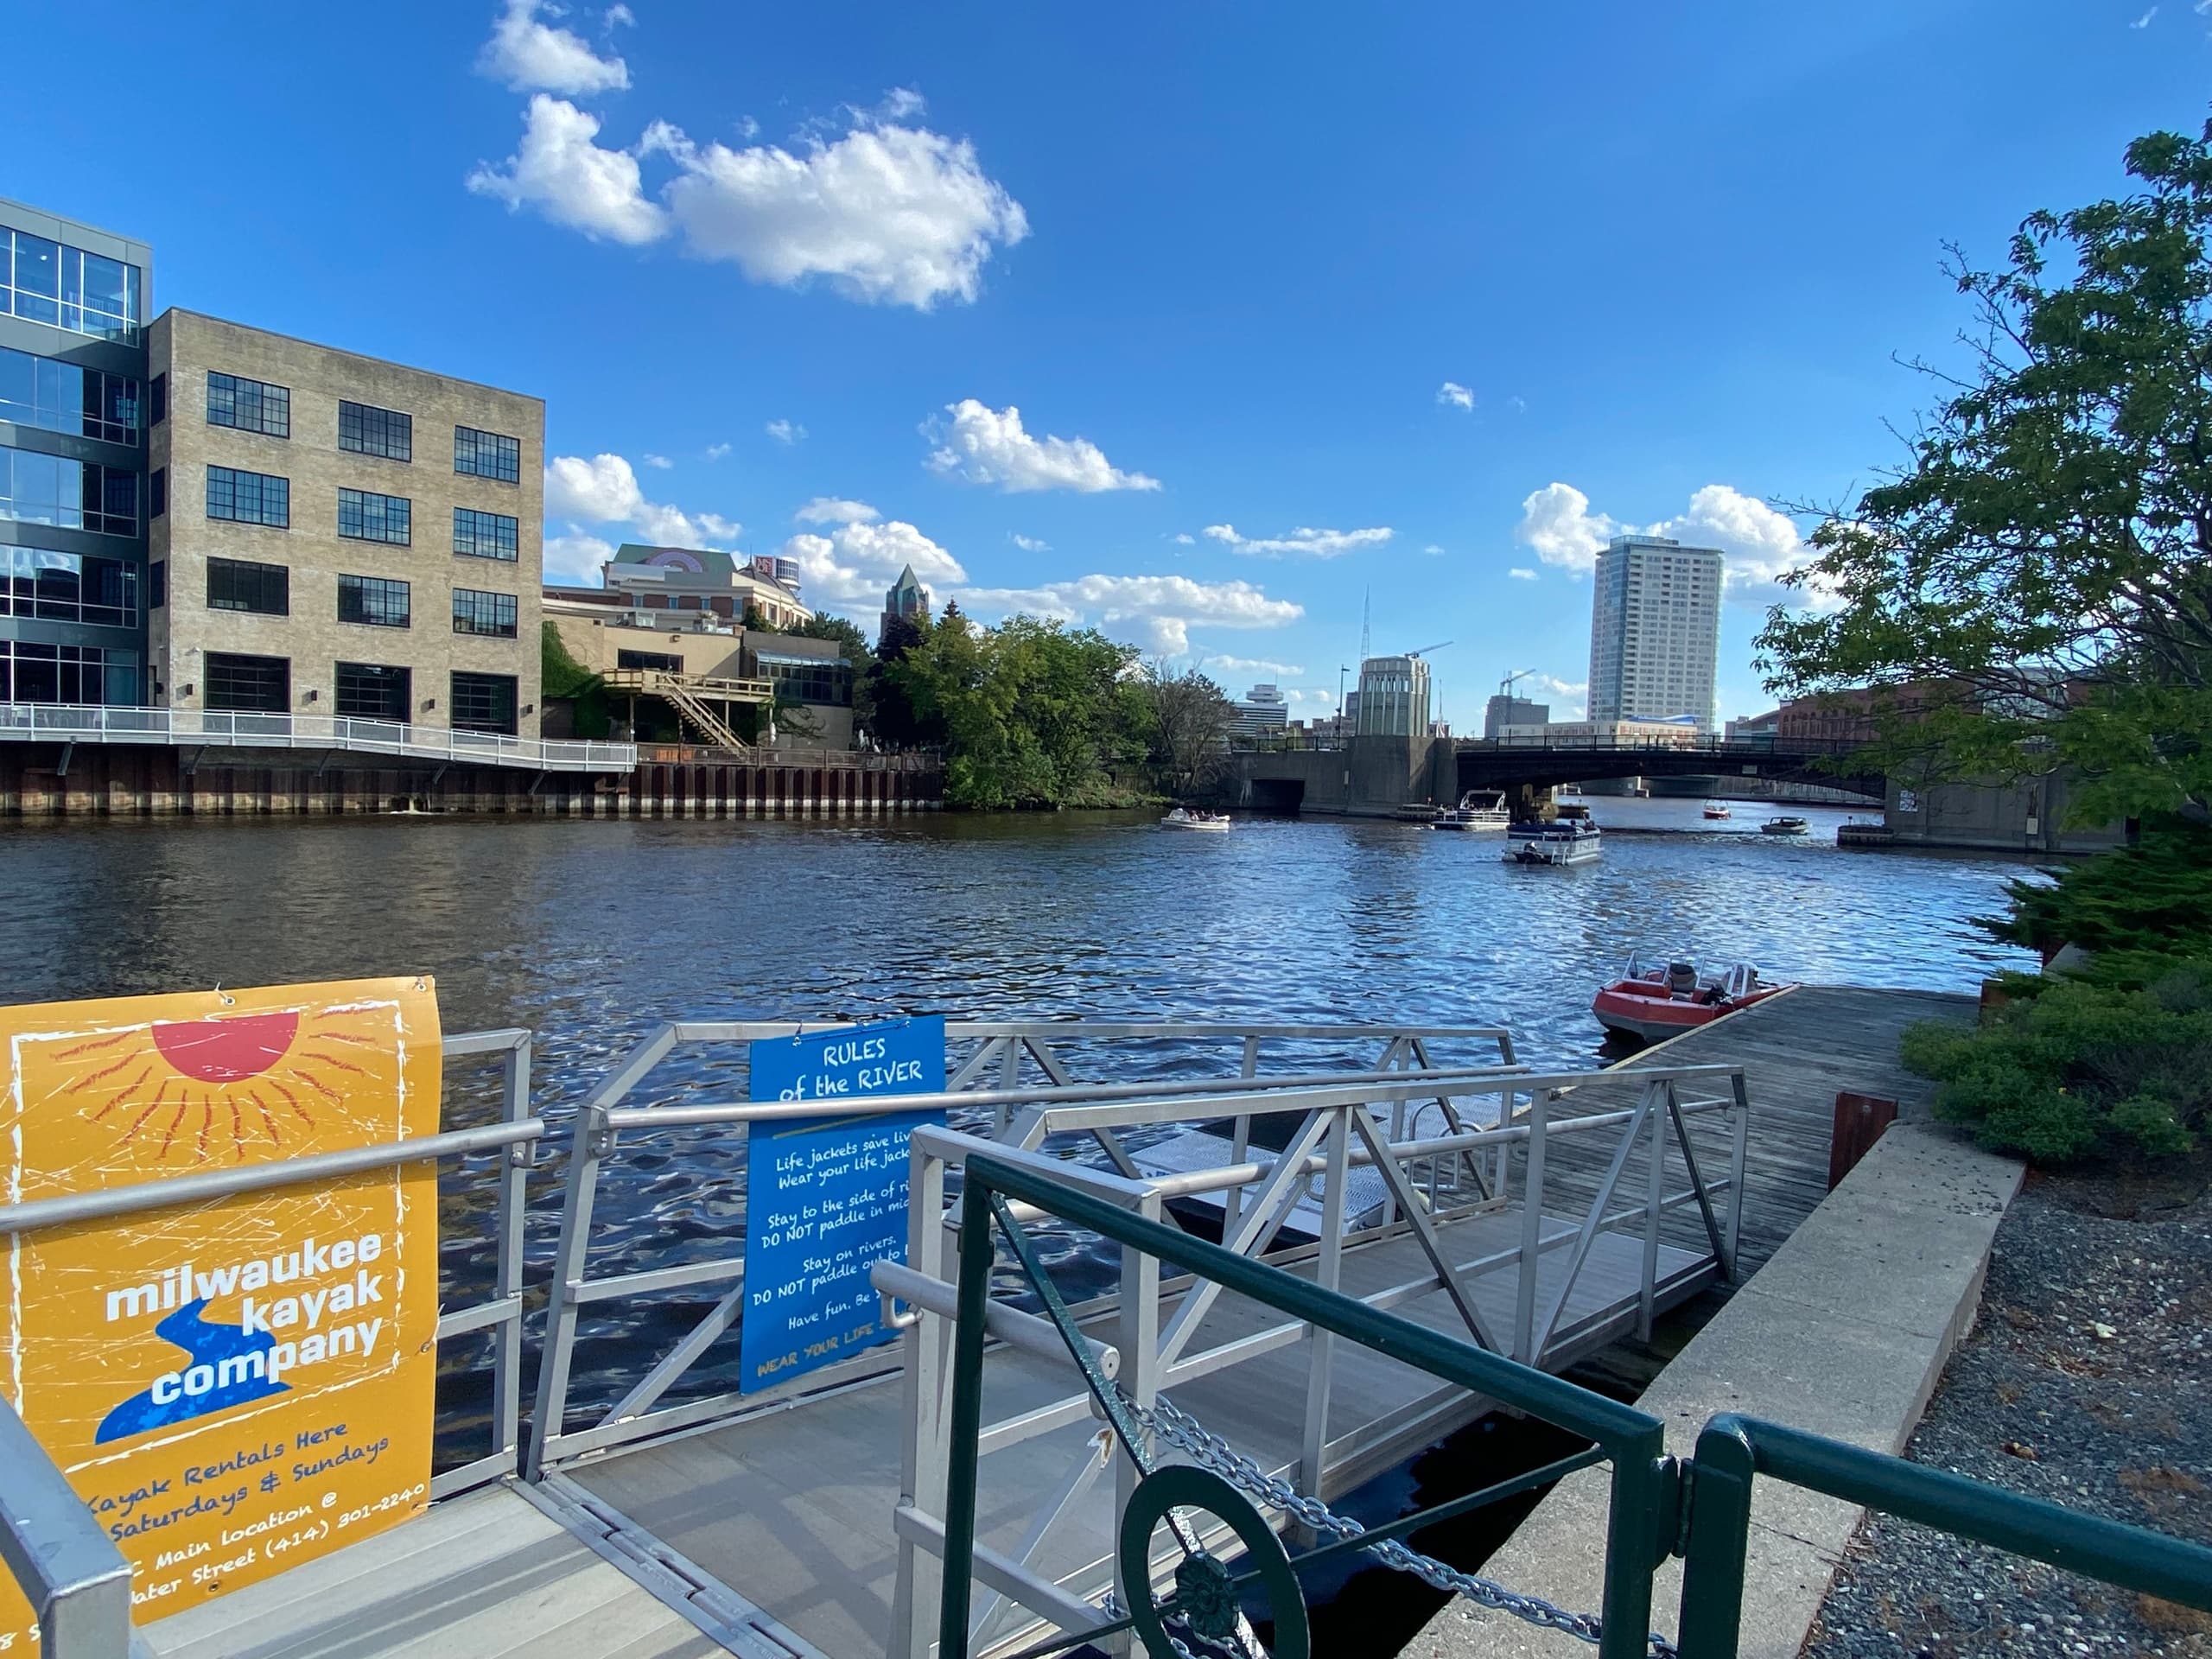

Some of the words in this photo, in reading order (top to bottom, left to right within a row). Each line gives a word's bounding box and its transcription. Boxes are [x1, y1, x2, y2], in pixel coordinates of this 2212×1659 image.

[823, 1038, 886, 1067] RULES
[779, 1075, 807, 1102] of
[815, 1075, 849, 1096] the
[858, 1060, 923, 1090] RIVER
[776, 1152, 804, 1172] Life
[807, 1142, 858, 1169] jackets
[862, 1137, 890, 1152] save
[893, 1131, 911, 1144] liv
[779, 1173, 813, 1190] Wear
[818, 1164, 850, 1187] your
[854, 1153, 878, 1172] life
[880, 1148, 910, 1169] jack
[761, 1232, 780, 1249] DO
[786, 1222, 814, 1243] NOT
[820, 1213, 866, 1240] paddle
[870, 1206, 883, 1217] in
[767, 1212, 798, 1230] Stay
[803, 1205, 817, 1219] to
[823, 1199, 844, 1213] the
[849, 1189, 876, 1207] side
[880, 1180, 895, 1198] of
[899, 1179, 910, 1193] ri
[106, 1233, 383, 1322] milwaukee
[753, 1289, 772, 1306] DO
[778, 1278, 806, 1299] NOT
[811, 1264, 857, 1294] paddle
[887, 1249, 900, 1262] to
[803, 1257, 831, 1274] Stay
[836, 1249, 854, 1262] on
[859, 1235, 897, 1255] rivers.
[242, 1268, 384, 1337] kayak
[788, 1313, 819, 1331] Have
[825, 1300, 851, 1321] fun.
[855, 1294, 871, 1306] Be
[151, 1317, 384, 1406] company
[757, 1351, 798, 1377] WEAR
[804, 1337, 839, 1359] YOUR
[843, 1322, 874, 1344] LIFE
[184, 1443, 284, 1486] Rentals
[296, 1423, 348, 1450] Here
[110, 1486, 248, 1541] Saturdays
[260, 1471, 282, 1493] &
[292, 1438, 389, 1482] Sundays
[130, 1578, 182, 1605] ater
[191, 1548, 257, 1585] Street
[264, 1519, 329, 1559] (414)
[337, 1483, 425, 1529] 301-2240
[156, 1541, 213, 1571] Main
[221, 1506, 314, 1546] Location
[321, 1492, 338, 1509] @
